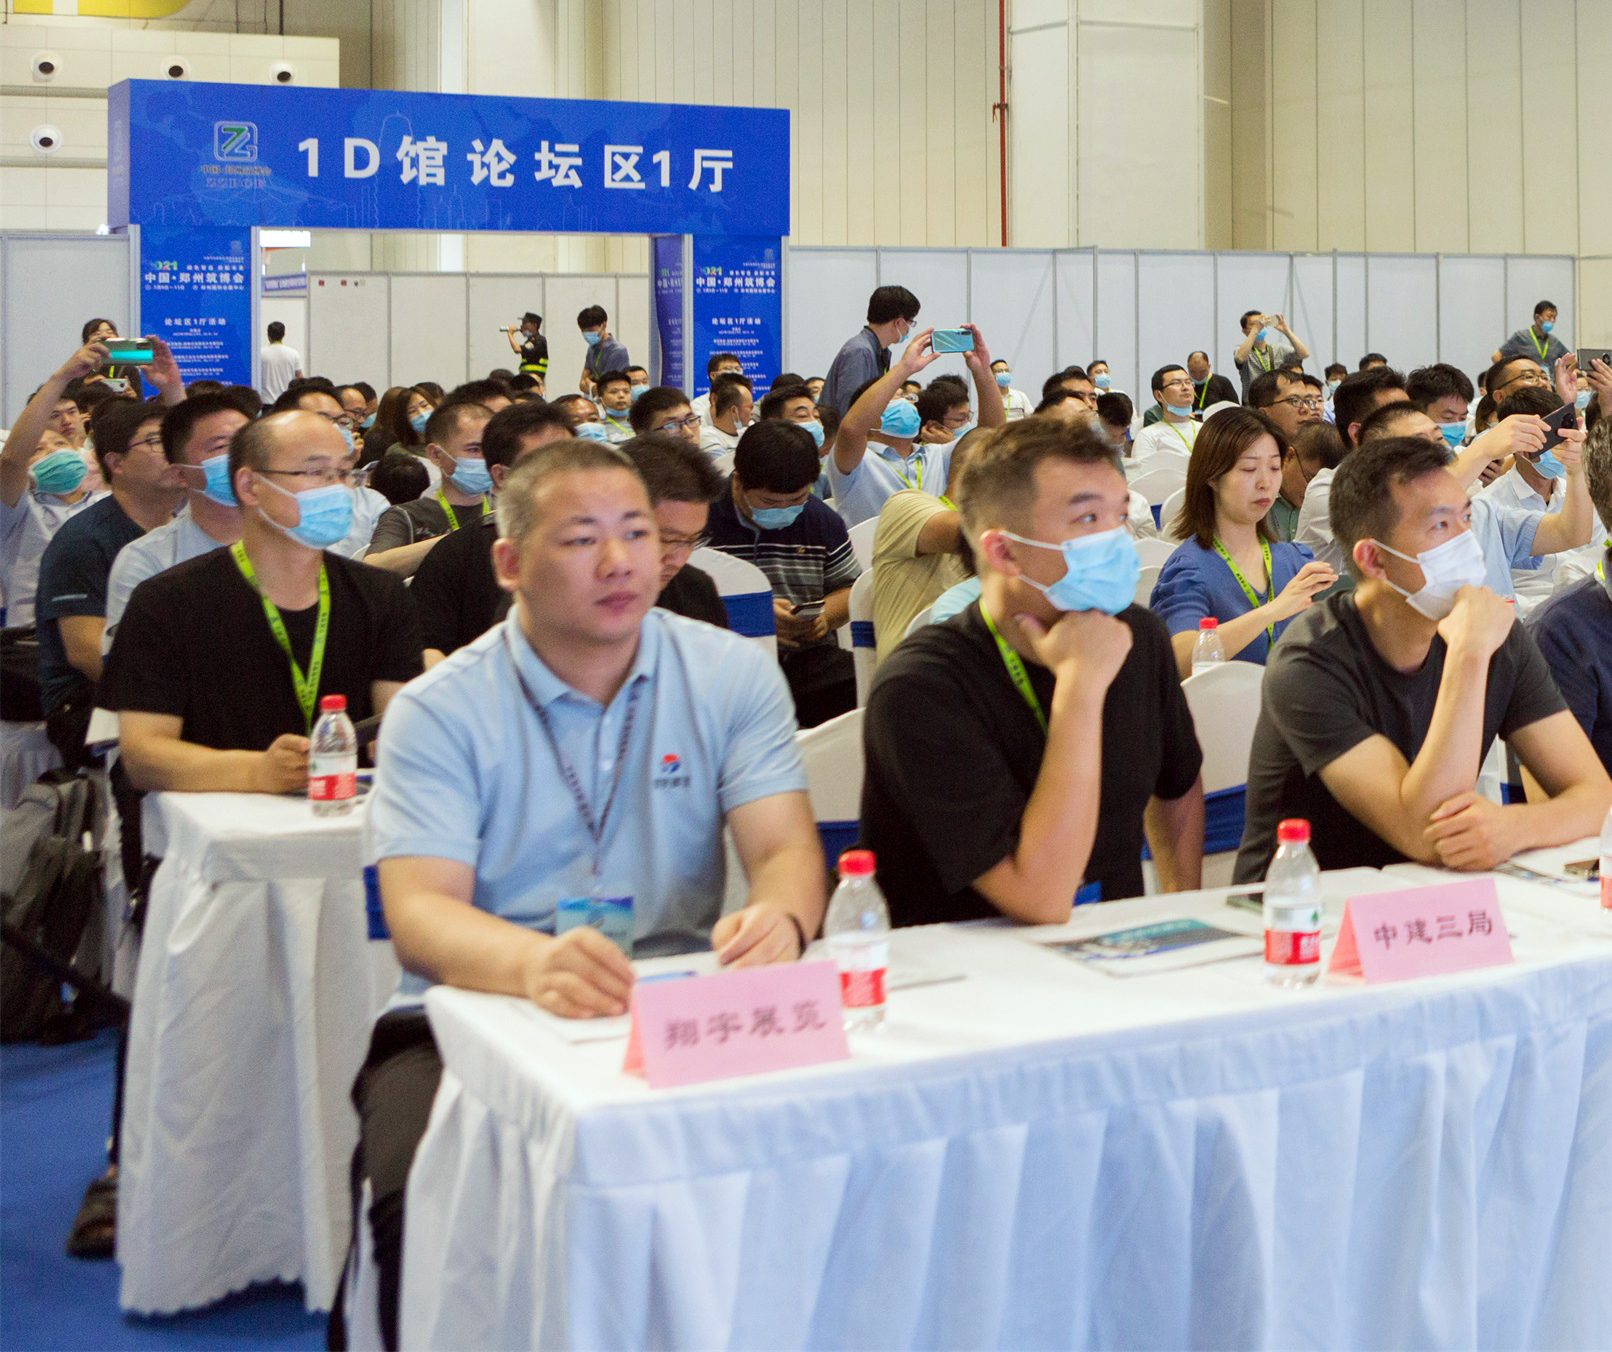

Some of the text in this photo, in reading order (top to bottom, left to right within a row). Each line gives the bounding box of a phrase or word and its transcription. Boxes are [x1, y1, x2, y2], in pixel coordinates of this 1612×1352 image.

[298, 136, 733, 192] 1D馆论坛区1厅
[1373, 909, 1494, 950] 中建三局
